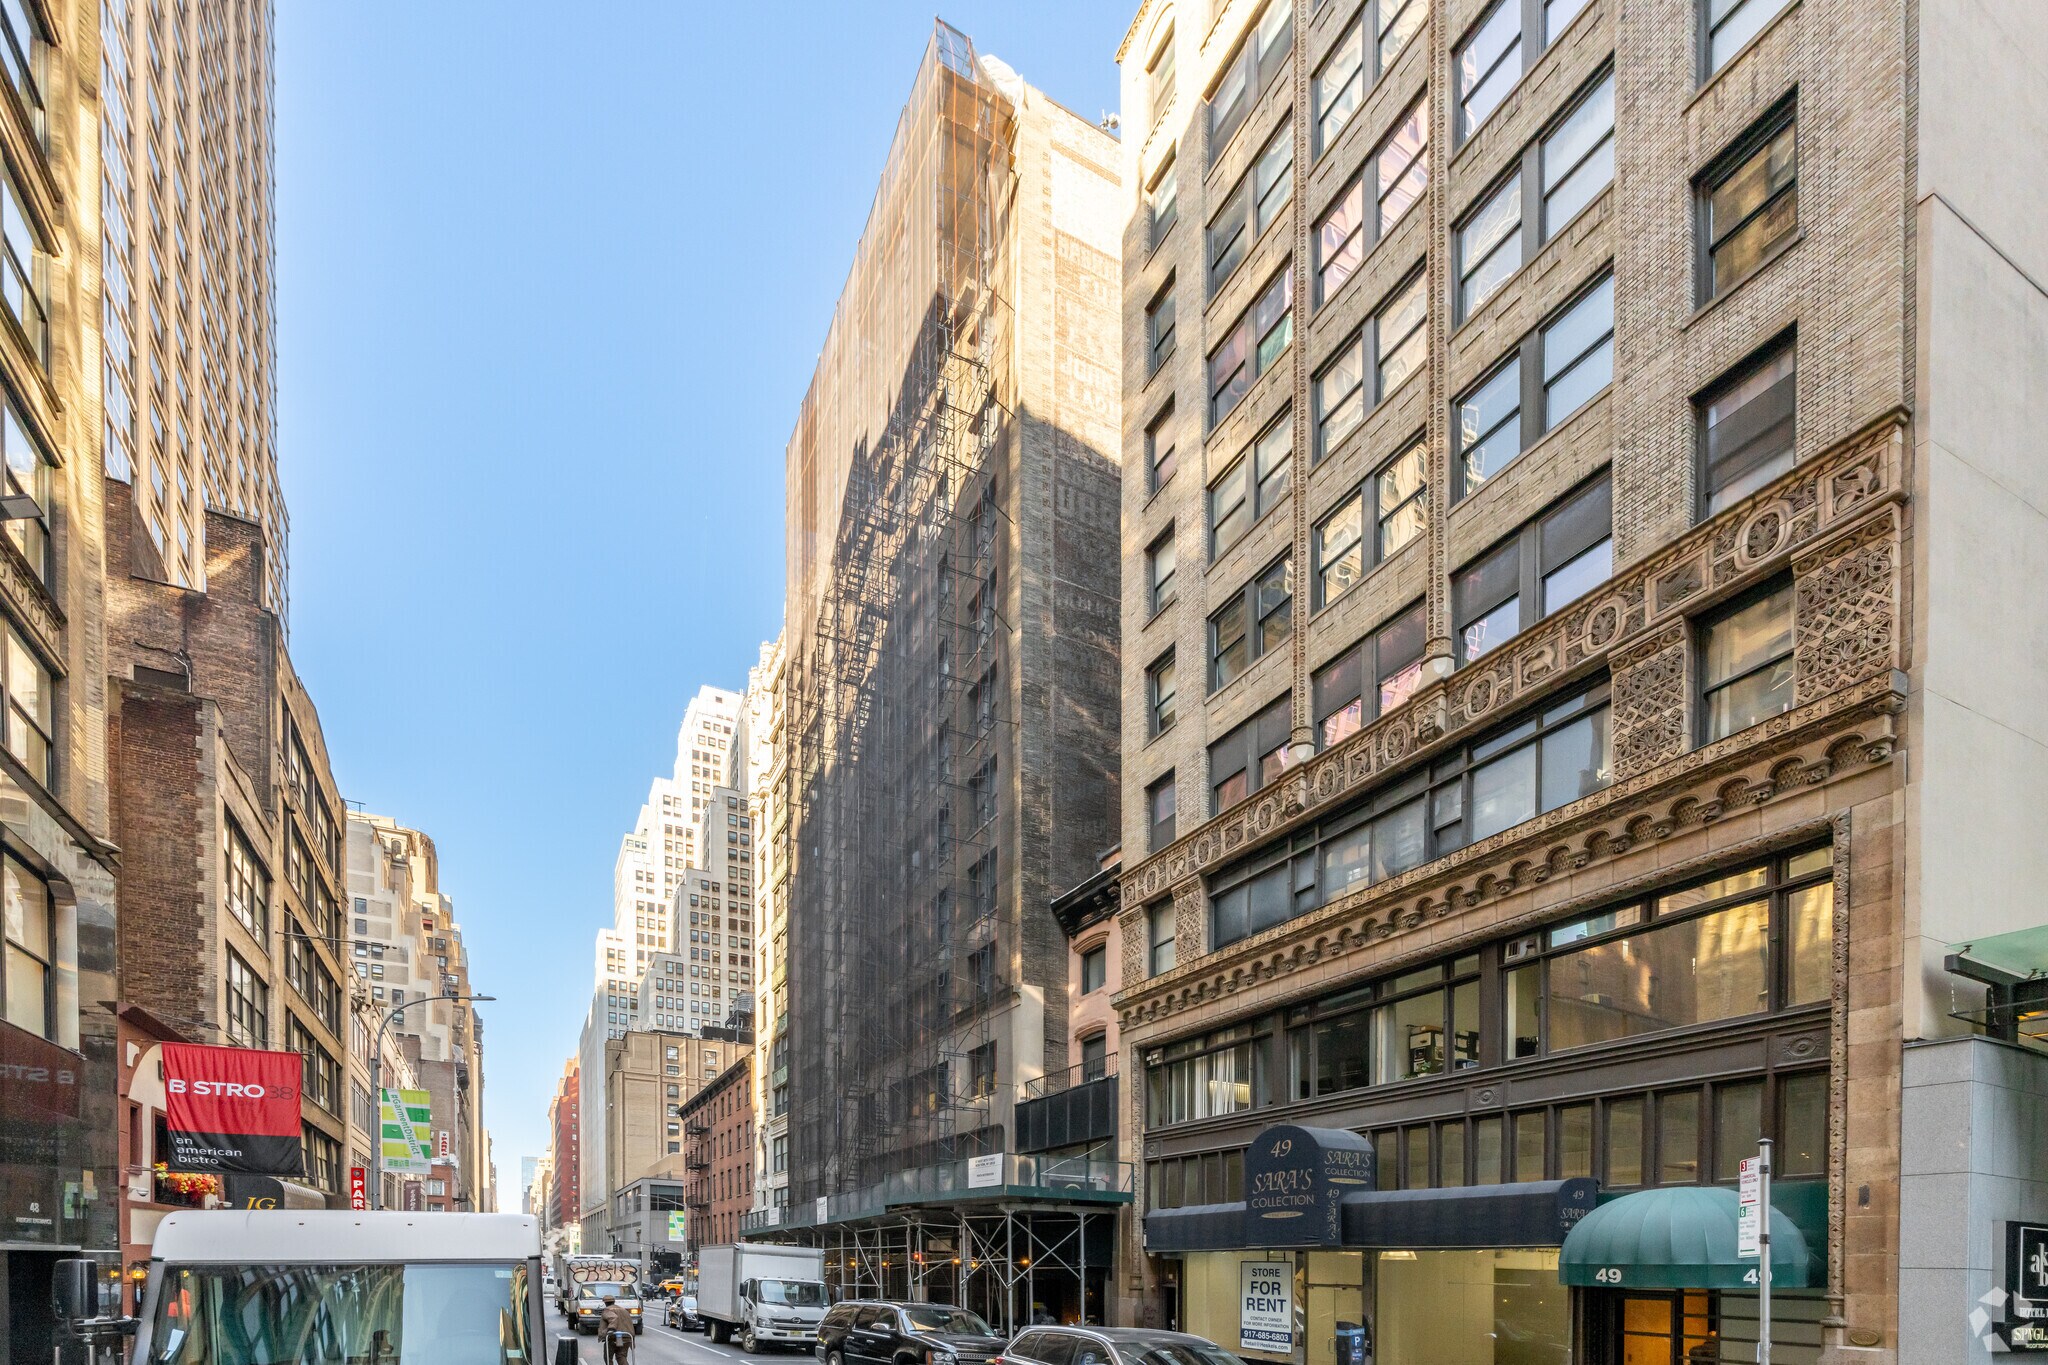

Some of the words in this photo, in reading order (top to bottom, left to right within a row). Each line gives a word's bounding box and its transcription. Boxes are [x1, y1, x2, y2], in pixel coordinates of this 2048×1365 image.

[391, 1094, 420, 1155] #GarmentDistrict
[176, 1137, 193, 1145] an
[177, 1146, 243, 1157] american
[1270, 1139, 1292, 1158] 49
[178, 1154, 219, 1165] bistro
[1324, 1150, 1371, 1169] SARA'S
[1741, 1161, 1746, 1171] 3
[1324, 1167, 1371, 1178] COLLECTION
[1252, 1168, 1313, 1195] SARA'S
[1326, 1189, 1340, 1199] 49
[1572, 1190, 1585, 1199] 49
[1251, 1194, 1315, 1209] COLLECTION
[30, 1202, 40, 1213] 48
[1740, 1207, 1746, 1217] 6
[1251, 1267, 1281, 1277] STORE
[1596, 1268, 1622, 1283] 49
[1250, 1281, 1281, 1295] FOR
[1246, 1297, 1287, 1313] RENT
[1243, 1329, 1289, 1342] 917-685-6803
[1354, 1336, 1361, 1347] P
